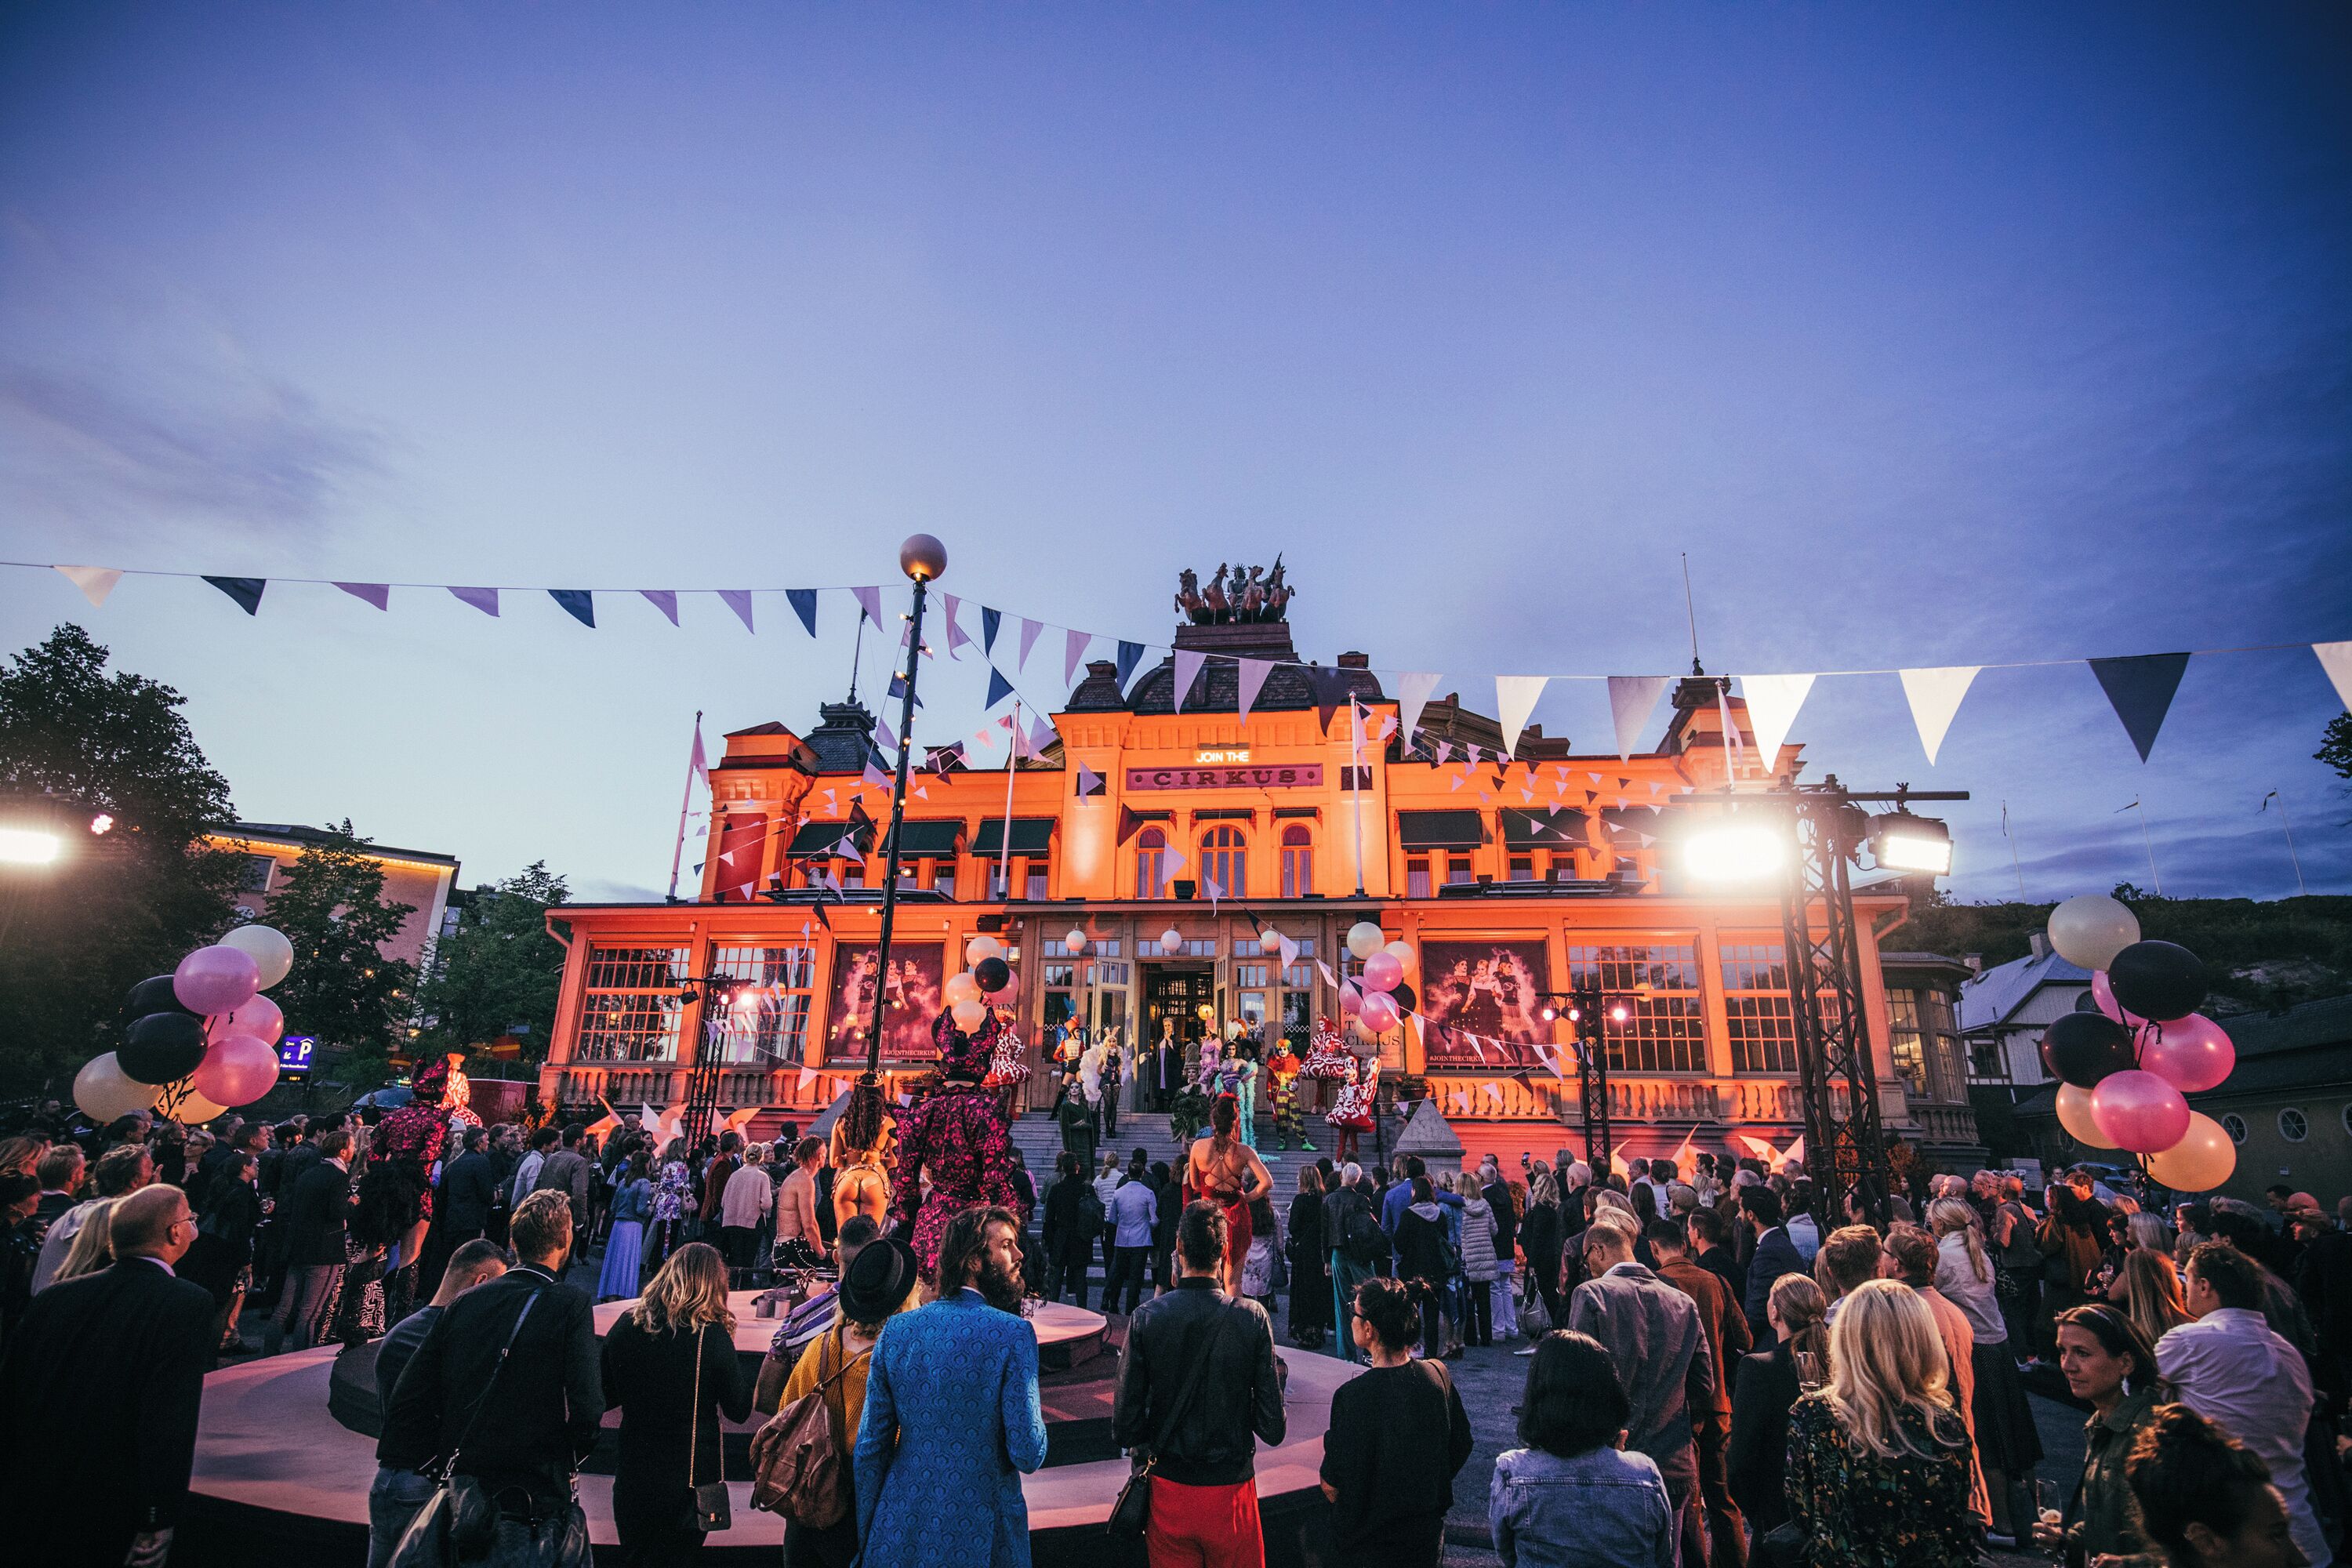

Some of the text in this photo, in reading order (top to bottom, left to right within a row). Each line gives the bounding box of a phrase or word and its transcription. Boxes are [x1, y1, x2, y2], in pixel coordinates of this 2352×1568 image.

[1196, 751, 1249, 763] JOIN THE
[1154, 770, 1296, 786] CIRKUS
[1346, 1035, 1400, 1046] CIUS
[298, 1042, 311, 1061] P
